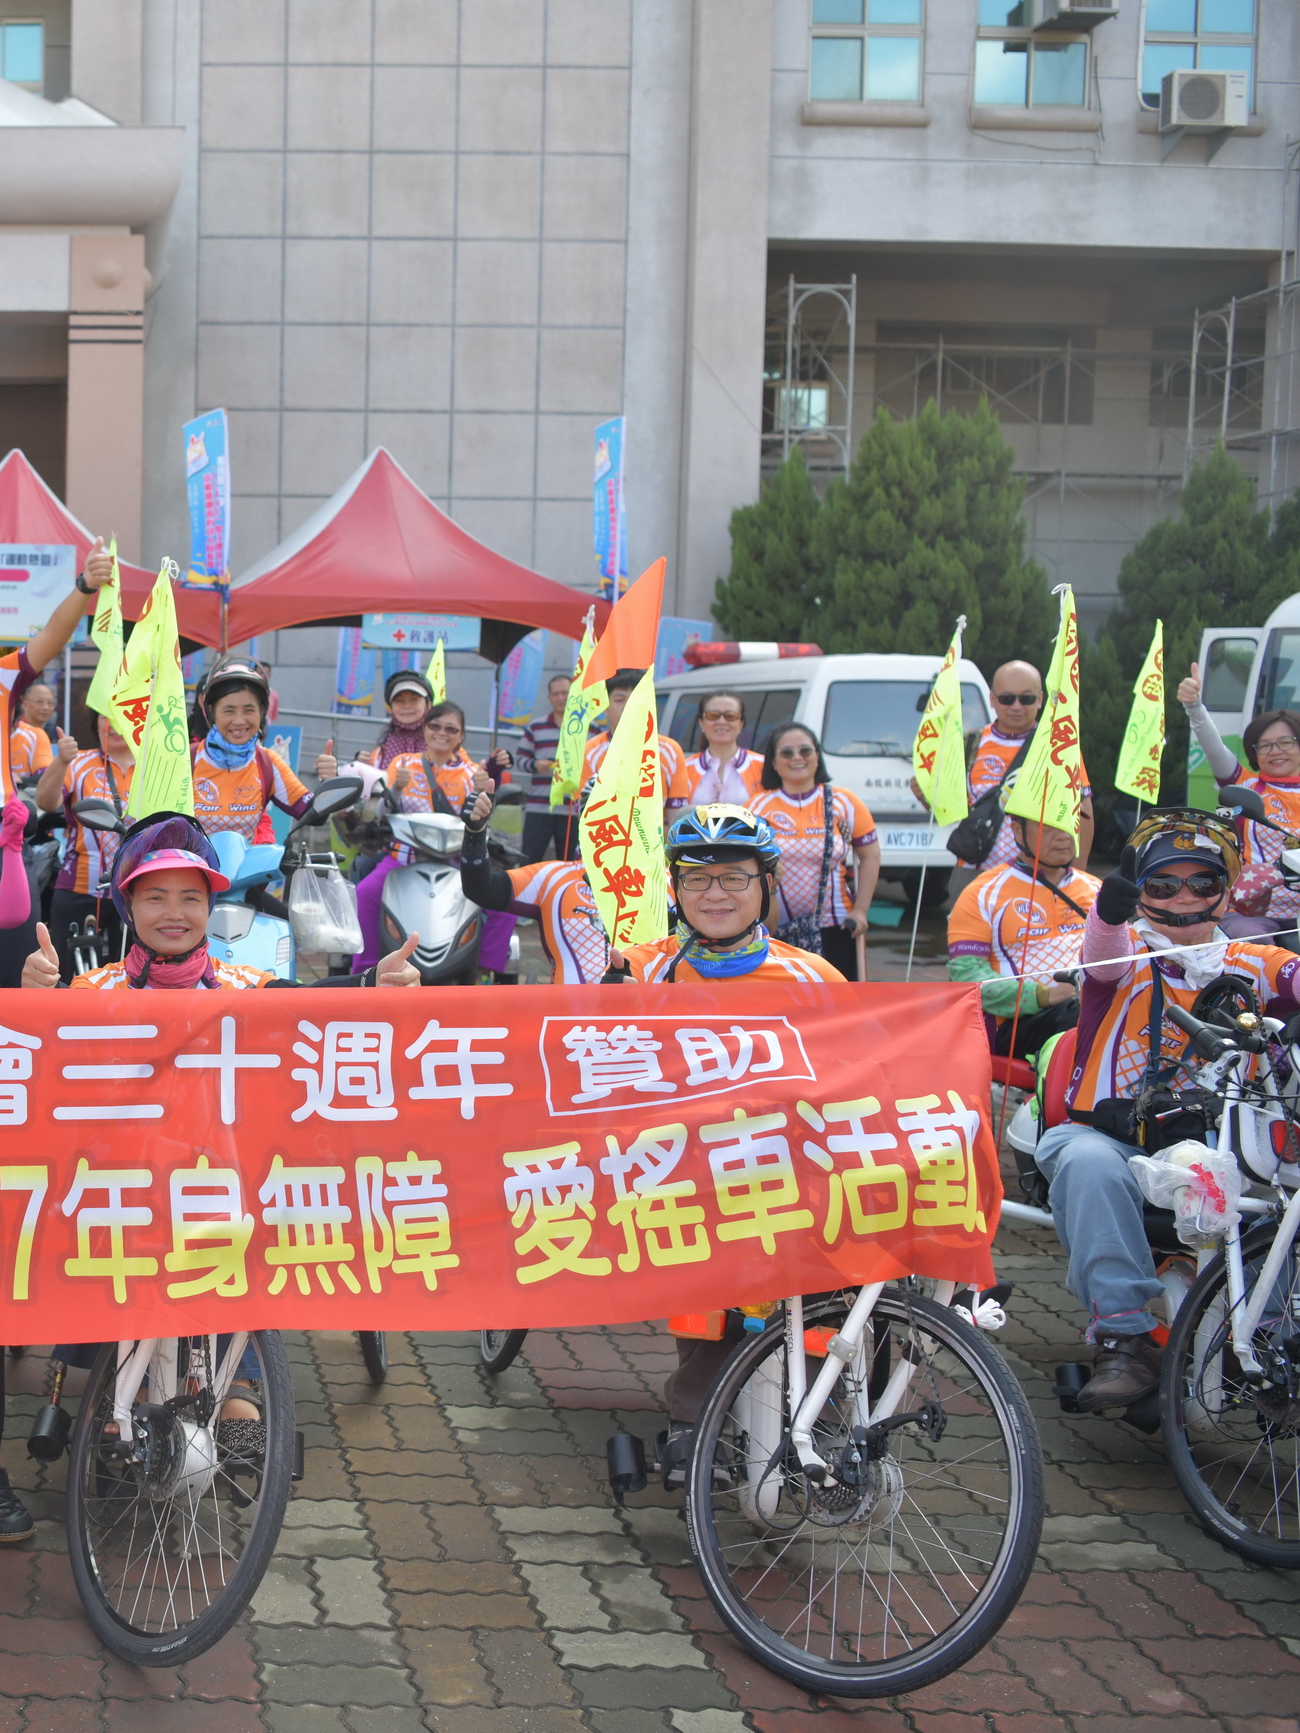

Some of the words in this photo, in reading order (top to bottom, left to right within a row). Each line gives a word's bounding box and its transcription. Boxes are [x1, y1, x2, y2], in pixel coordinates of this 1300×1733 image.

[563, 1023, 784, 1105] 贊助
[502, 1089, 987, 1286] 愛搖車活動
